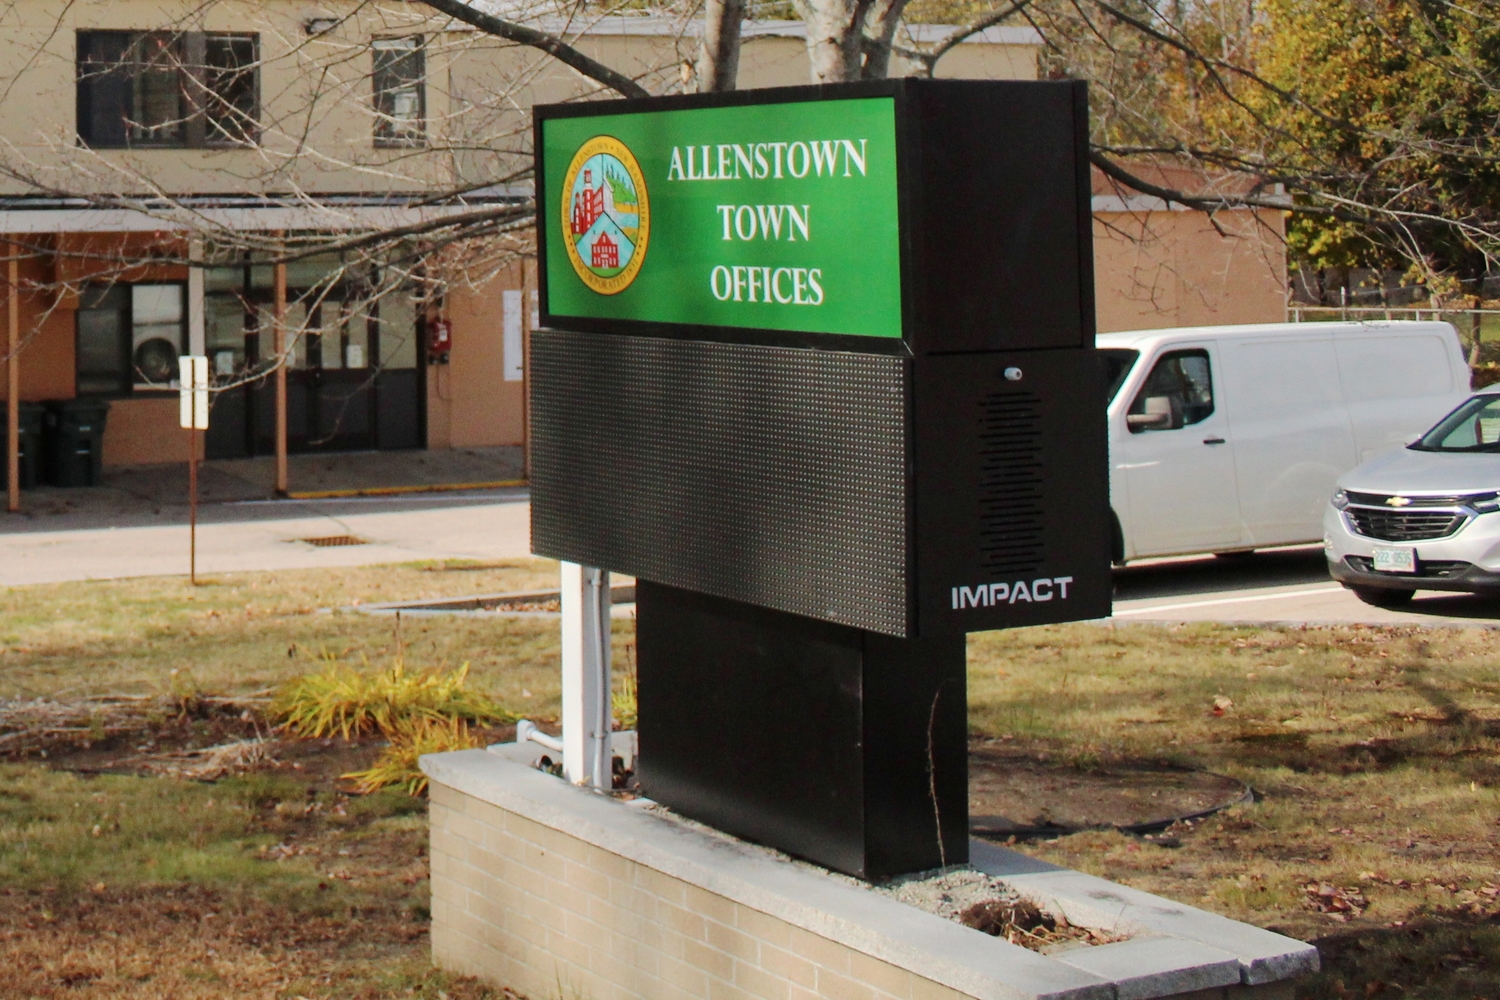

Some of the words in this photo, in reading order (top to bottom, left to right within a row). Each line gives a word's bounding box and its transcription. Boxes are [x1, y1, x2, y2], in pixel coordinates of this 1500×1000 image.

[668, 139, 867, 180] ALLENSTOWN
[717, 205, 809, 241] TOWN
[711, 265, 823, 305] OFFICES
[952, 576, 1073, 609] IMPACT
